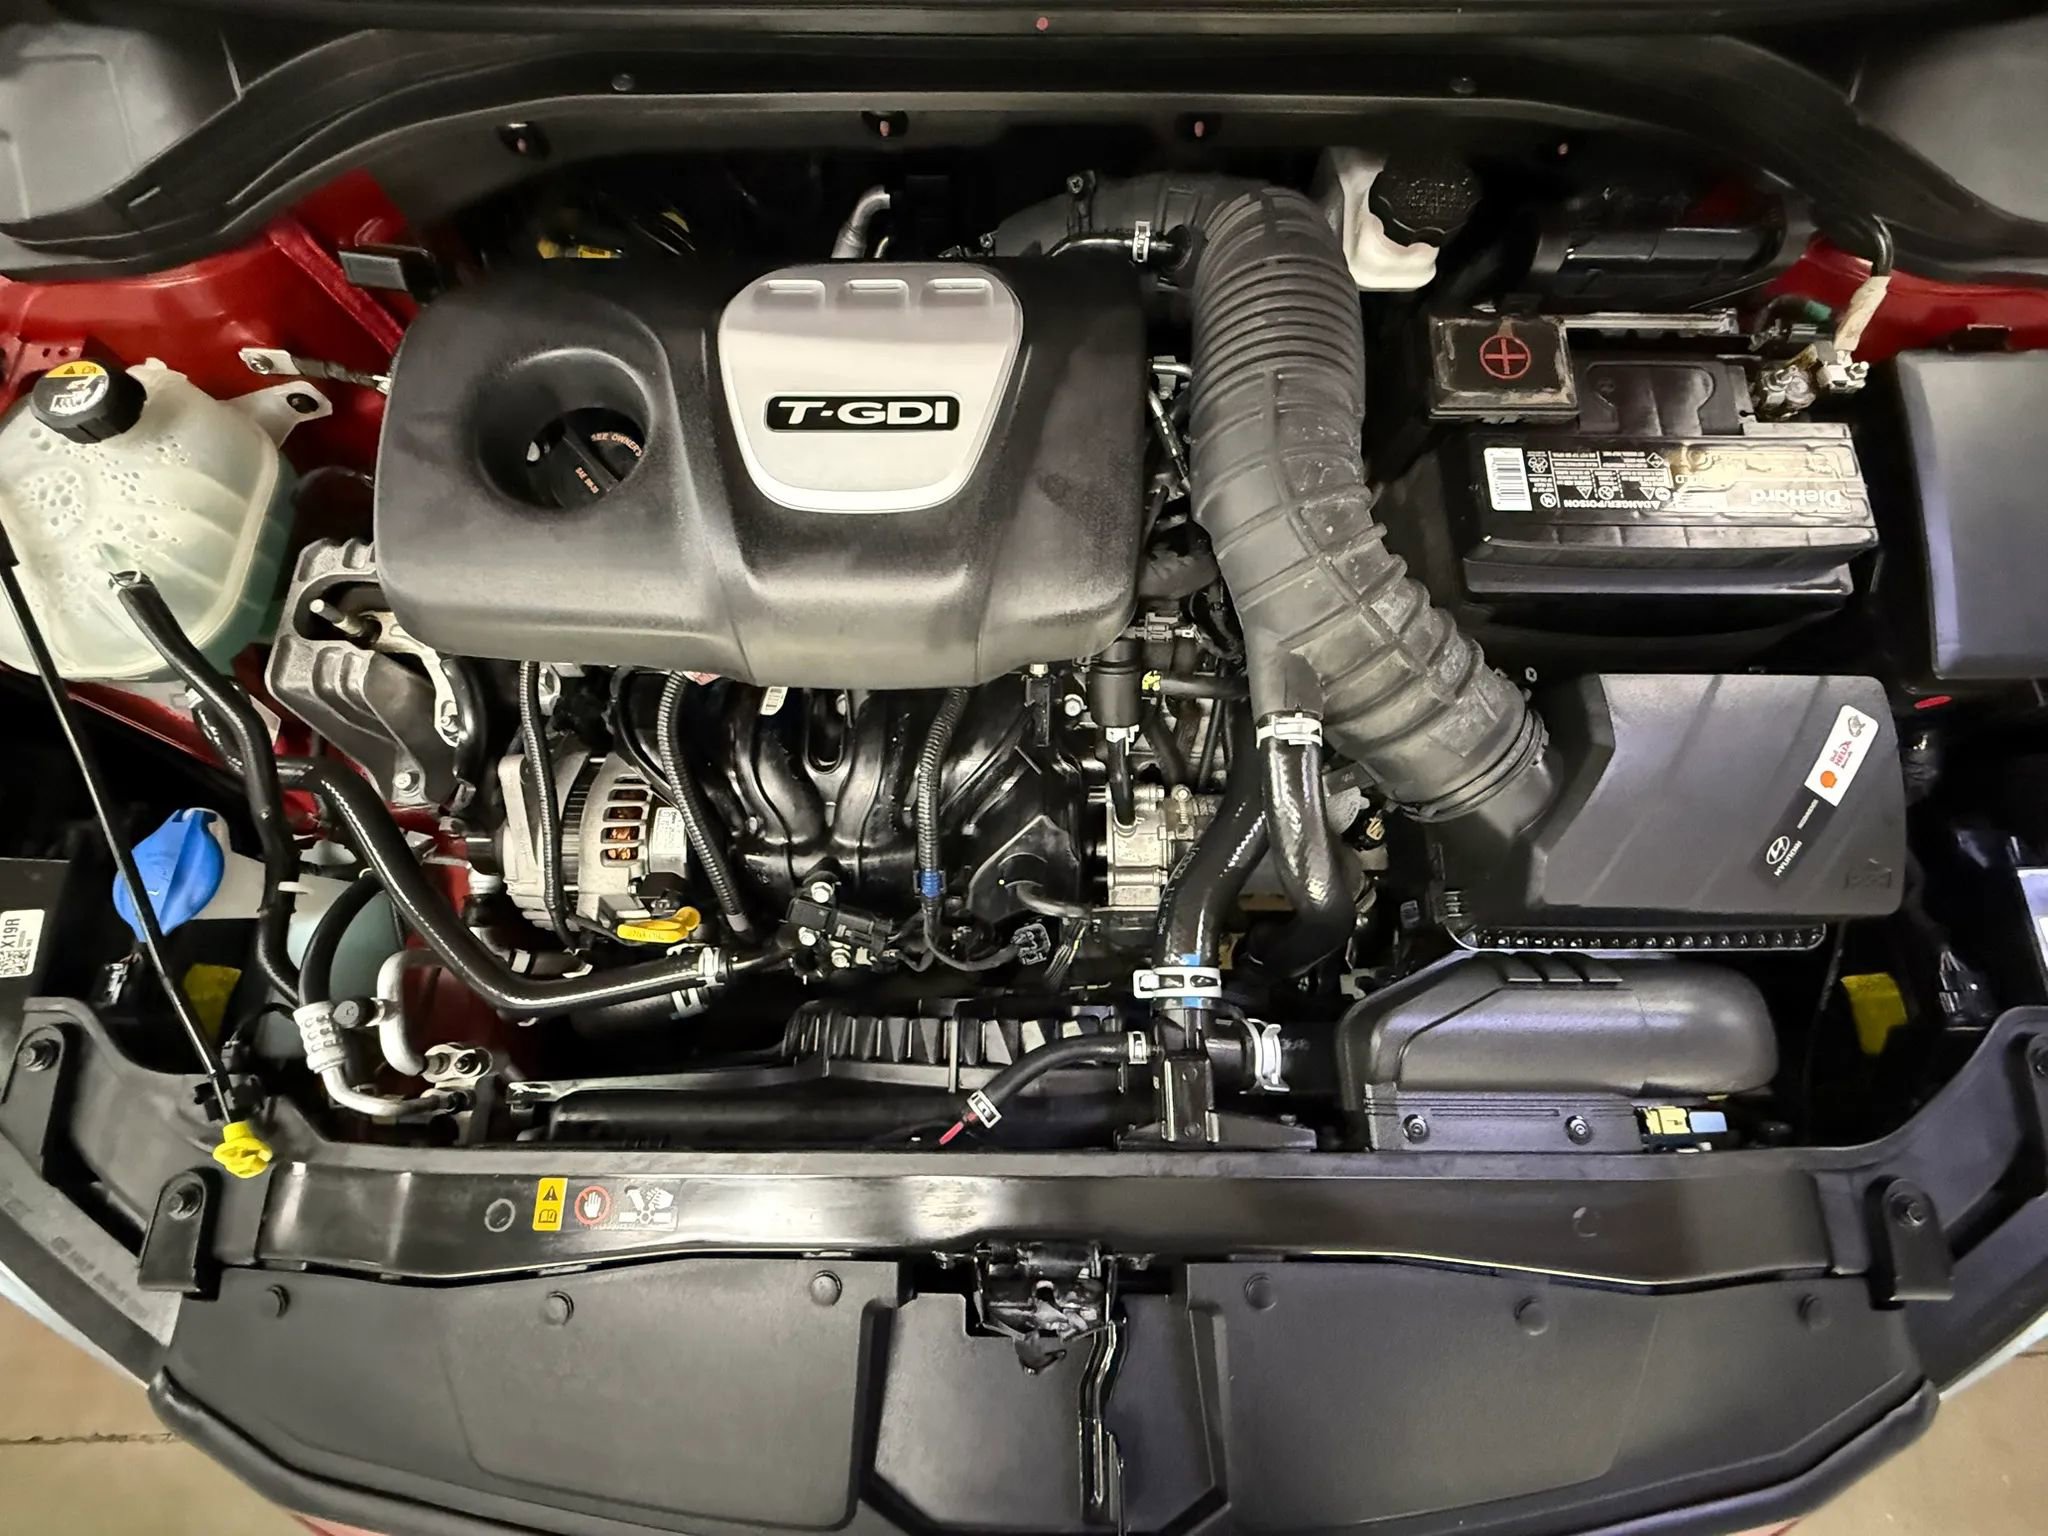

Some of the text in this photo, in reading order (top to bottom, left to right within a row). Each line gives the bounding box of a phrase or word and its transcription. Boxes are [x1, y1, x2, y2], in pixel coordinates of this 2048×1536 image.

[778, 401, 949, 425] T-GDI
[590, 432, 609, 442] SEE
[1563, 499, 1652, 510] DANGER/POISON
[1750, 488, 1842, 506] DieHard
[1774, 840, 1803, 877] HYUNDAI
[0, 918, 21, 948] X19R
